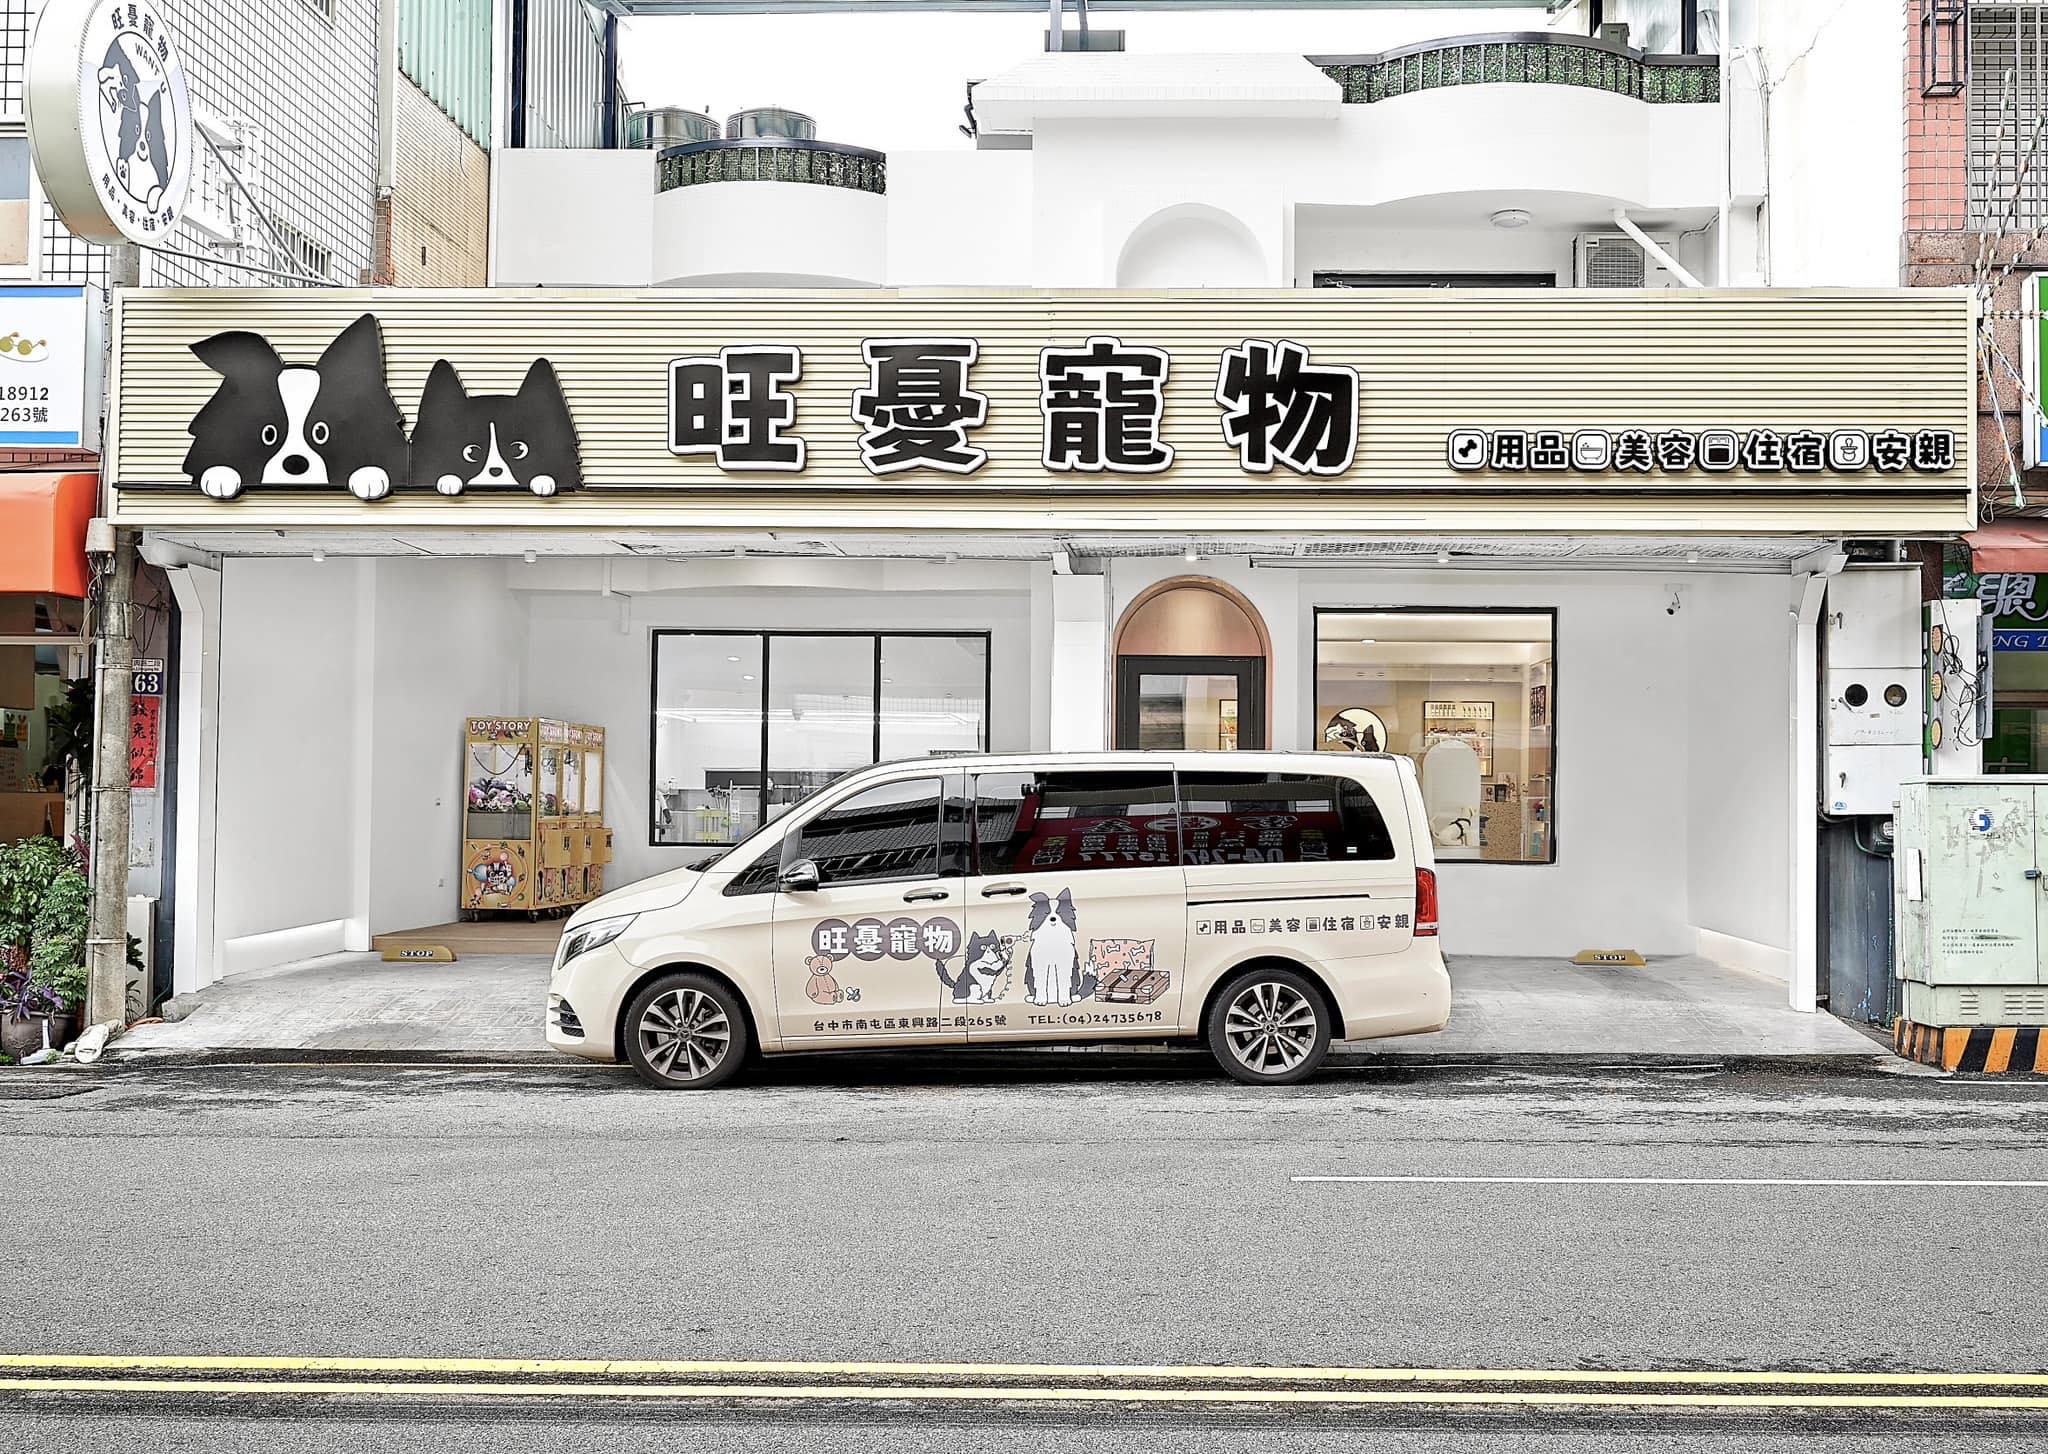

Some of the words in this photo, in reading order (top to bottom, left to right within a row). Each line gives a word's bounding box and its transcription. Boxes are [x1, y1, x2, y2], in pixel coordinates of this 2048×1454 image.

[111, 4, 168, 62] 旺憂寵物
[135, 42, 160, 77] WANT
[0, 407, 49, 423] 263號
[669, 338, 1360, 475] 旺憂寵物
[1490, 431, 1570, 470] 用品
[1615, 431, 1696, 470] 美容
[1744, 431, 1826, 470] 住宿
[1872, 431, 1956, 470] 安親
[134, 674, 158, 693] 63
[471, 720, 492, 731] TOY
[495, 720, 531, 731] STORY
[1213, 919, 1247, 935] 用品
[1268, 917, 1302, 933] 美容
[1322, 916, 1356, 932] 住宿
[1377, 913, 1410, 930] 安親
[818, 923, 954, 955] 旺憂寵物
[813, 1014, 1008, 1032] 台中市南屯區東興路二段265號
[1028, 1010, 1162, 1025] TEL:(04)24735678
